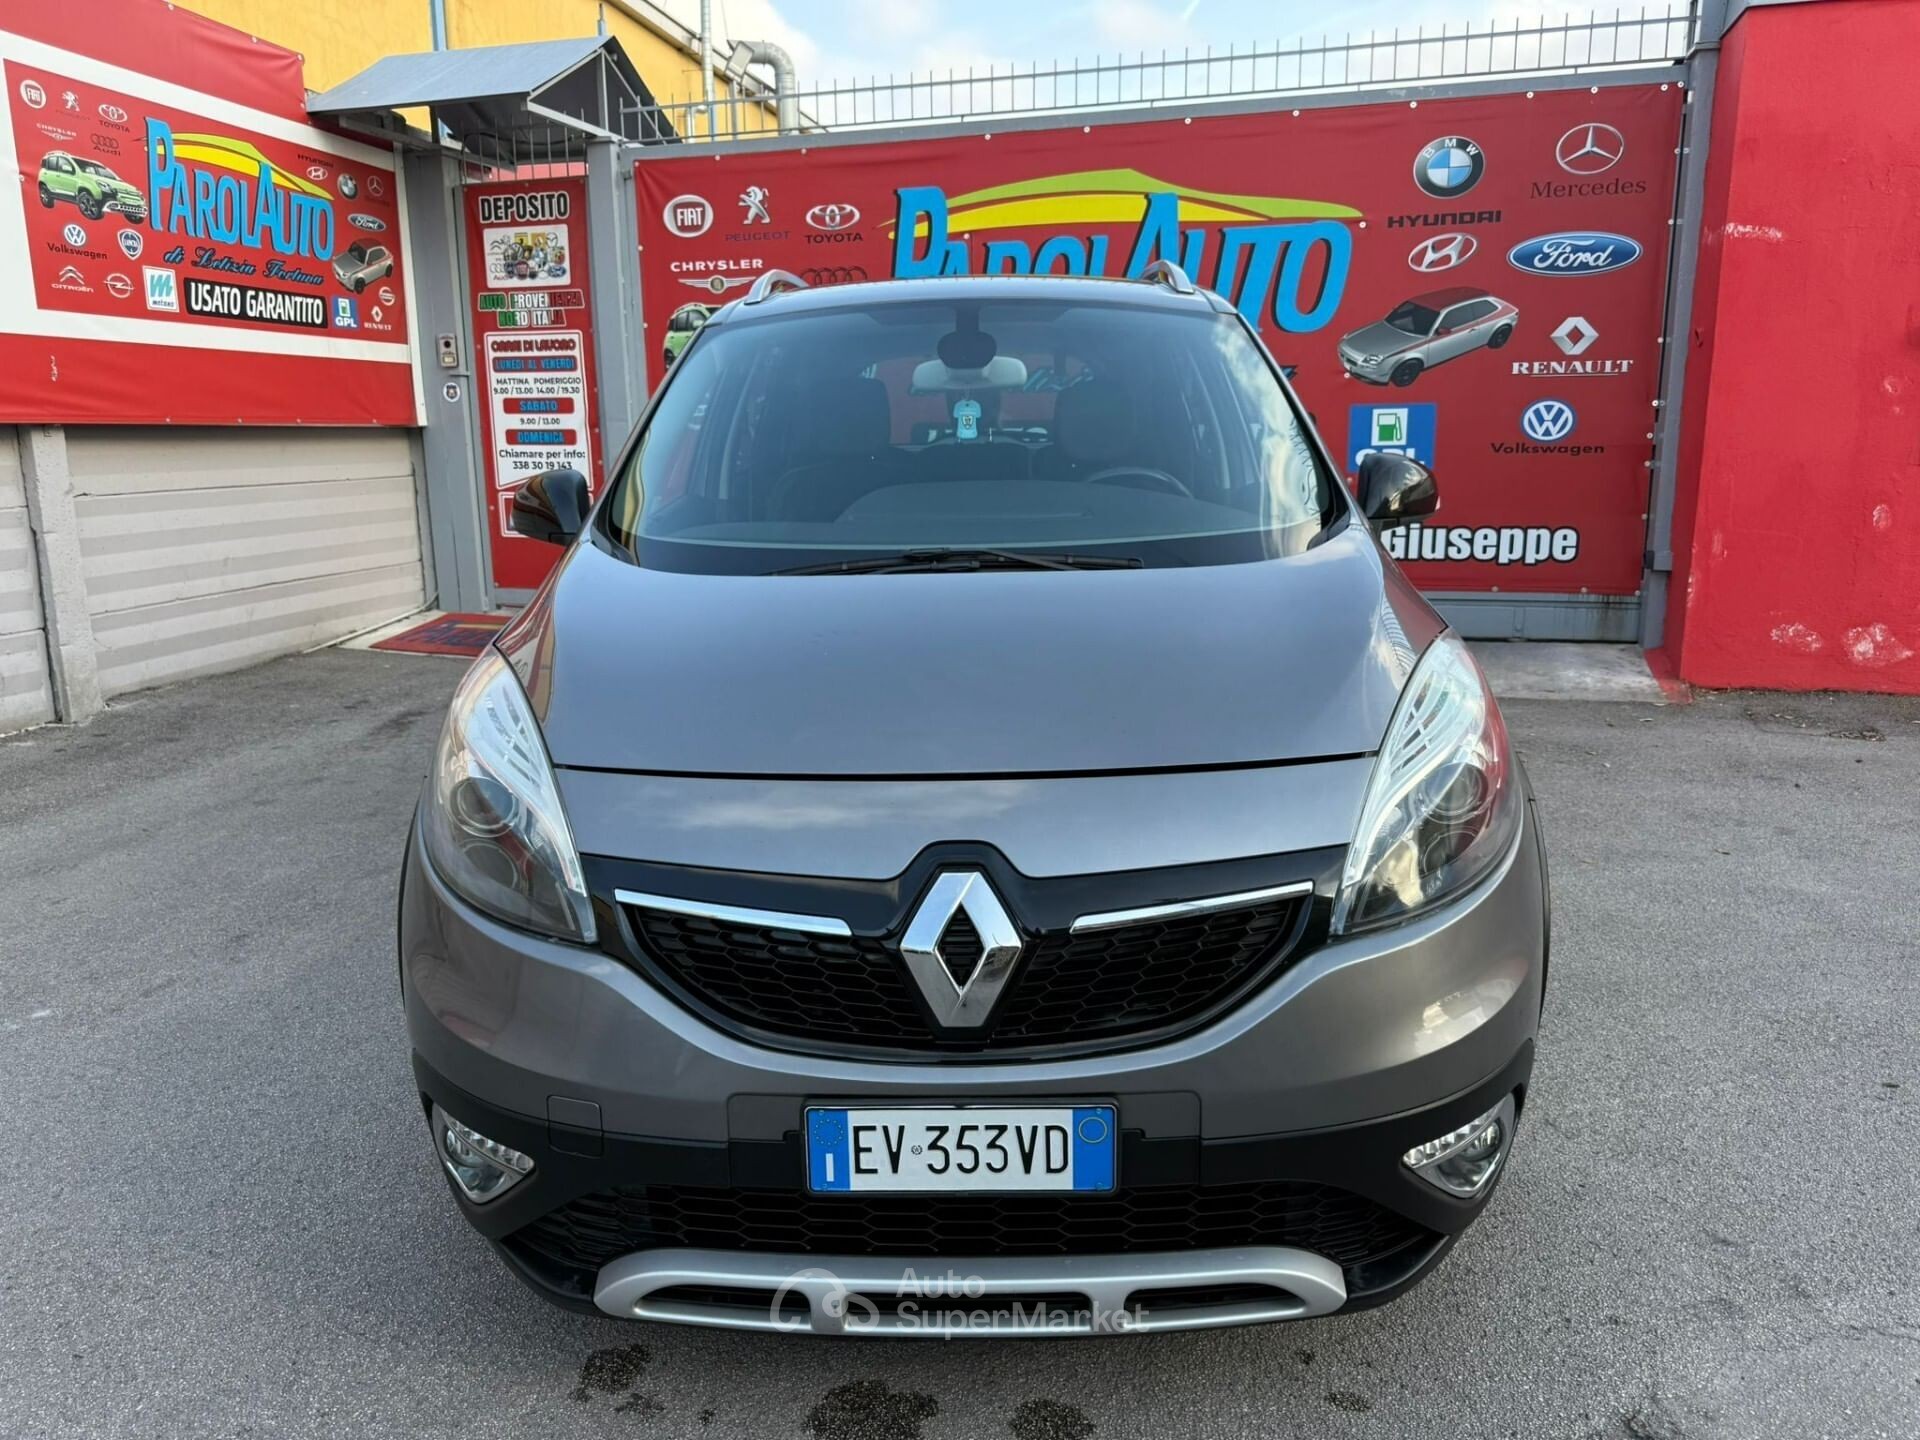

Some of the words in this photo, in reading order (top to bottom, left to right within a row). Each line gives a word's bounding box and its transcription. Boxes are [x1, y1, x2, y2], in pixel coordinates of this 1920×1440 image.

[99, 120, 130, 133] TOYOTA
[145, 116, 335, 261] PAROLAUTO
[1530, 179, 1647, 199] Mercedes
[480, 192, 569, 222] DEPOSITO
[676, 208, 703, 226] FIAT
[1387, 210, 1502, 228] HYUNDAI
[725, 230, 791, 242] PEUGEOT
[803, 233, 864, 244] TOYOTA
[47, 242, 108, 260] Volkswagen
[1533, 239, 1612, 267] Ford
[164, 246, 185, 264] di
[191, 247, 256, 276] Letizia
[264, 259, 324, 285] Fortuna
[670, 258, 764, 272] CHRYSLER
[190, 282, 241, 315] USATO
[246, 290, 323, 324] GARANTITO
[480, 293, 506, 311] AUTO
[335, 316, 357, 328] GPL
[498, 310, 530, 327] NORD
[1511, 360, 1634, 375] RENAULT
[533, 377, 581, 385] POMERIGGIO
[493, 387, 509, 395] 9.00
[561, 386, 580, 394] 19.30
[520, 400, 559, 412] SABATO
[517, 431, 565, 443] DOMENICA
[499, 448, 544, 458] Chiamare
[546, 451, 561, 460] per
[563, 449, 586, 458] info:
[1491, 442, 1605, 457] Volkswagen
[512, 461, 530, 470] 338
[531, 461, 543, 470] 30
[545, 461, 555, 470] 19
[557, 461, 573, 470] 143
[1380, 523, 1578, 564] Giuseppe
[853, 1125, 905, 1175] EV
[925, 1124, 1069, 1174] 353VD
[825, 1153, 835, 1182] I
